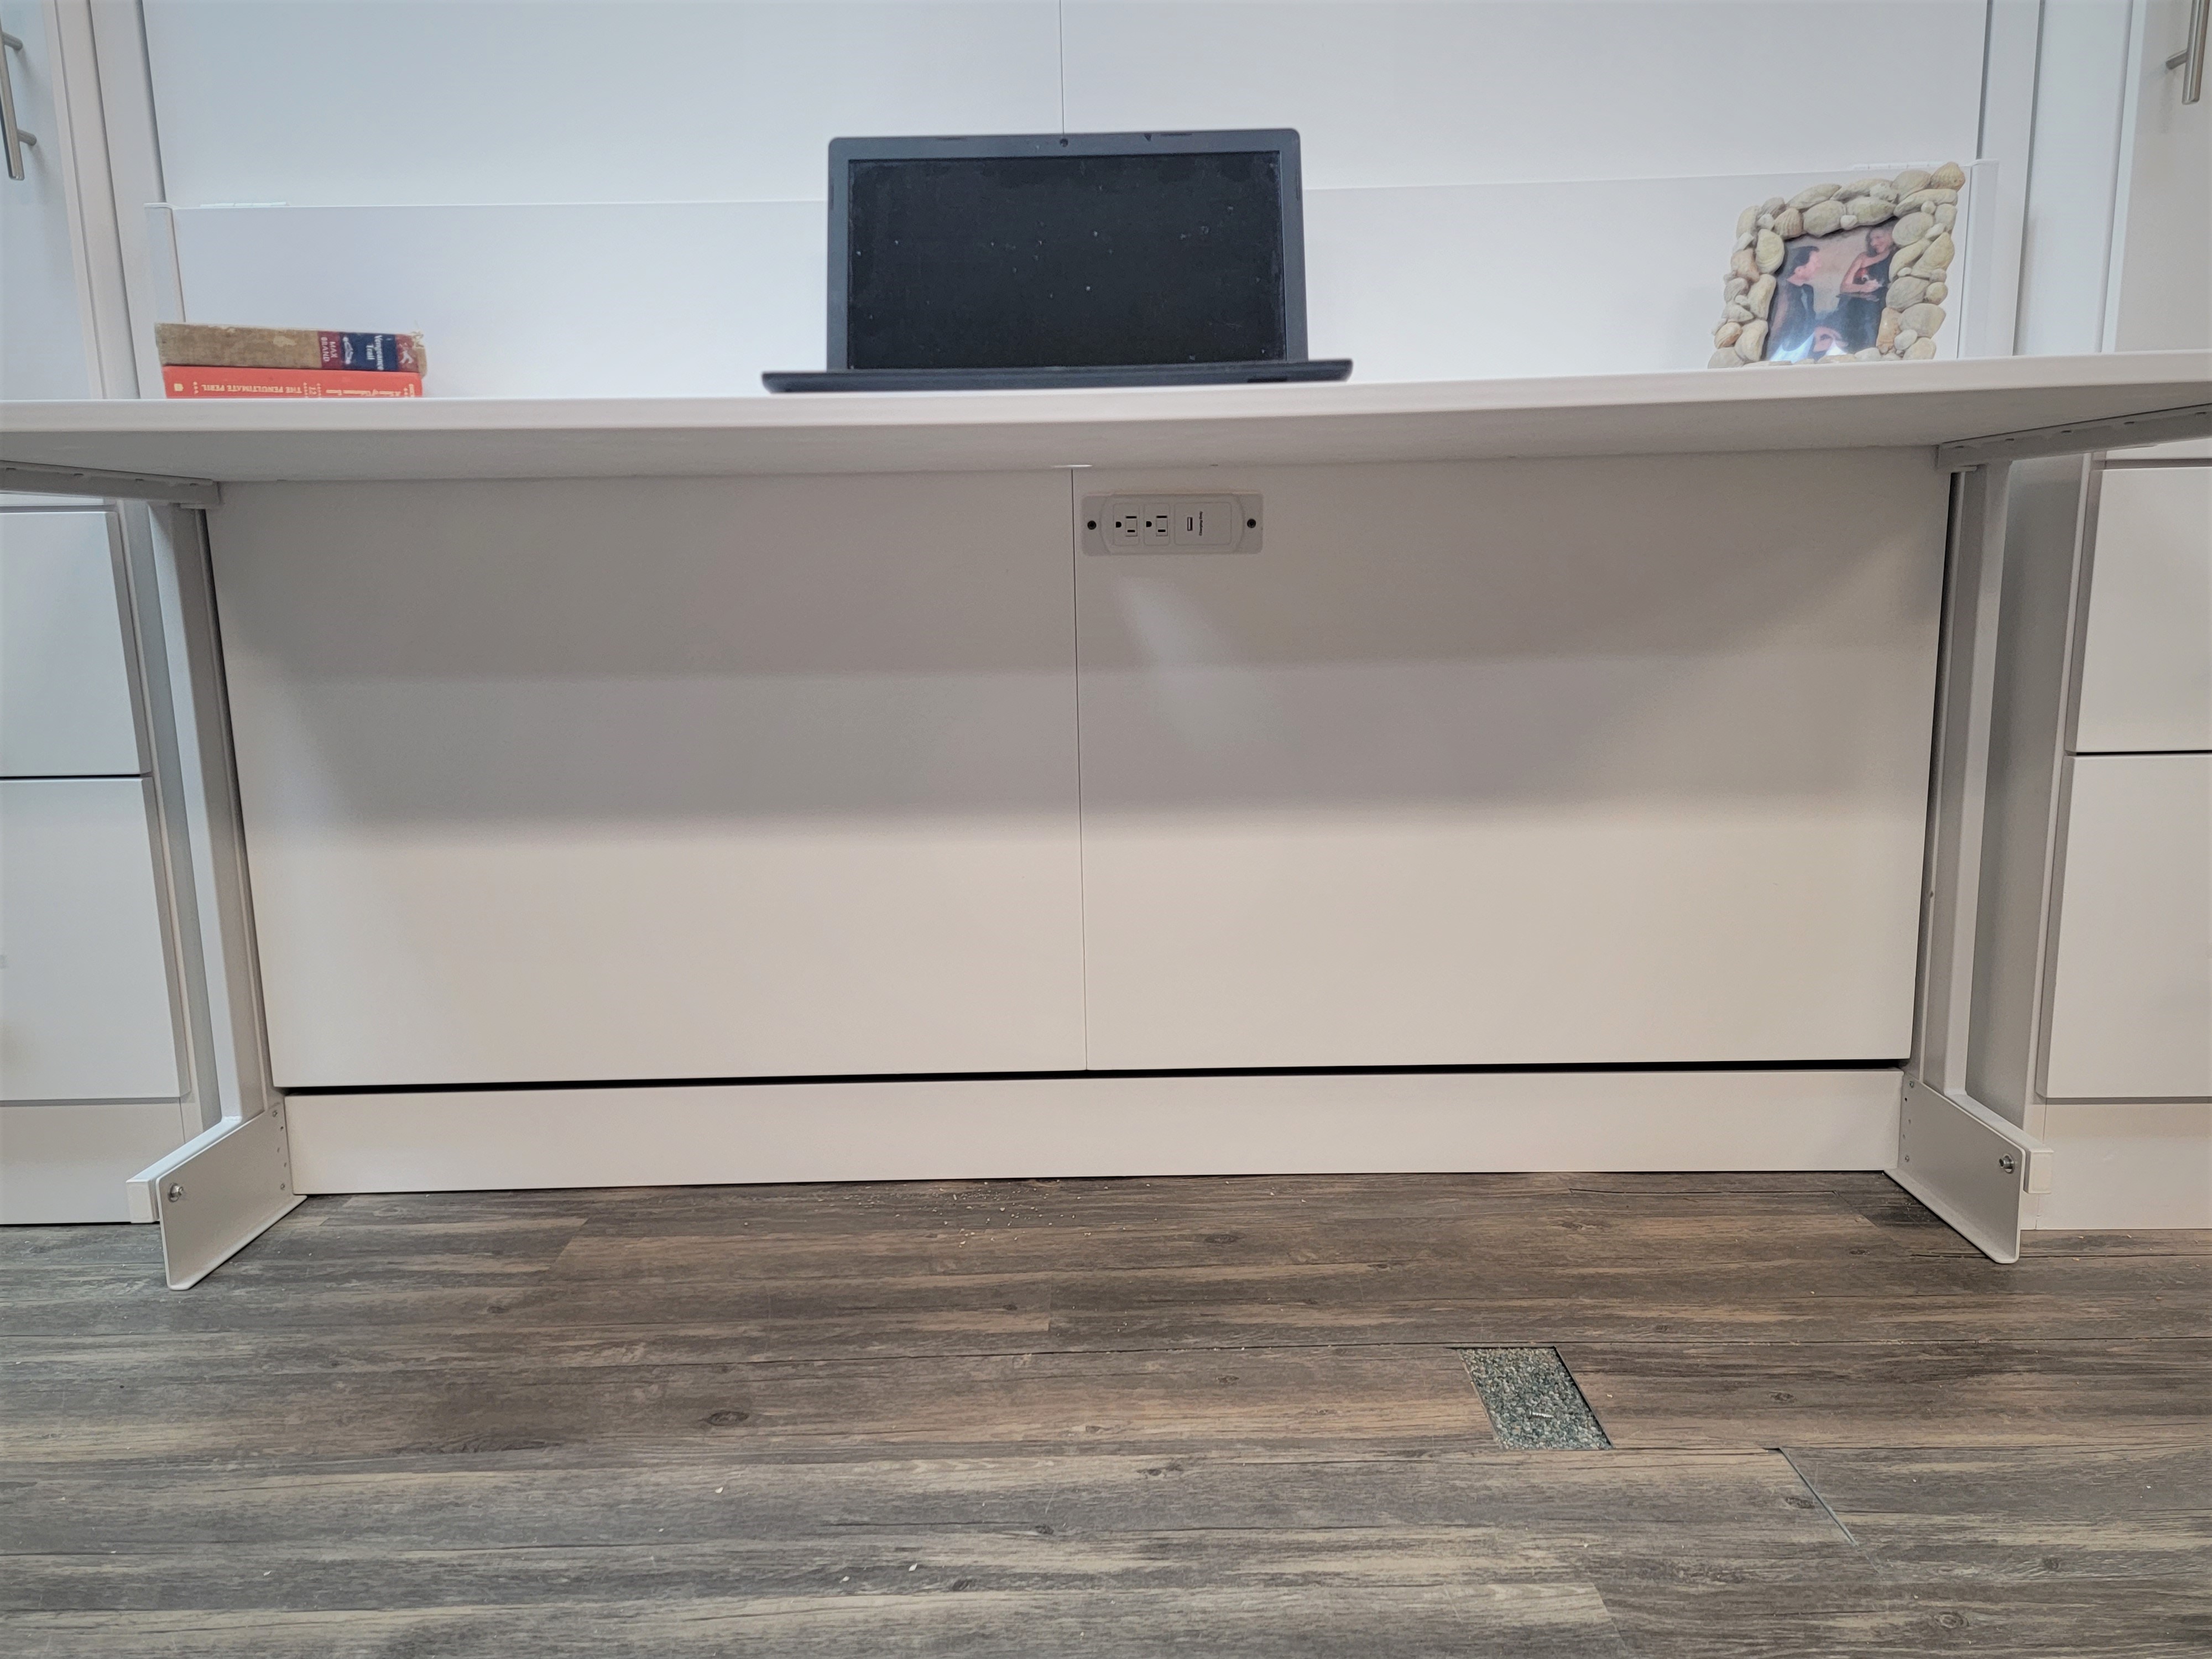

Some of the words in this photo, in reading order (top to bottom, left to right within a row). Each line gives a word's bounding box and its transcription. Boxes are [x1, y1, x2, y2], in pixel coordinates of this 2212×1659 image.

[321, 337, 330, 362] BRAND
[329, 341, 338, 358] MAX
[366, 345, 375, 361] Trail
[374, 335, 384, 371] Vengeance
[227, 385, 284, 393] PENULTIMATE
